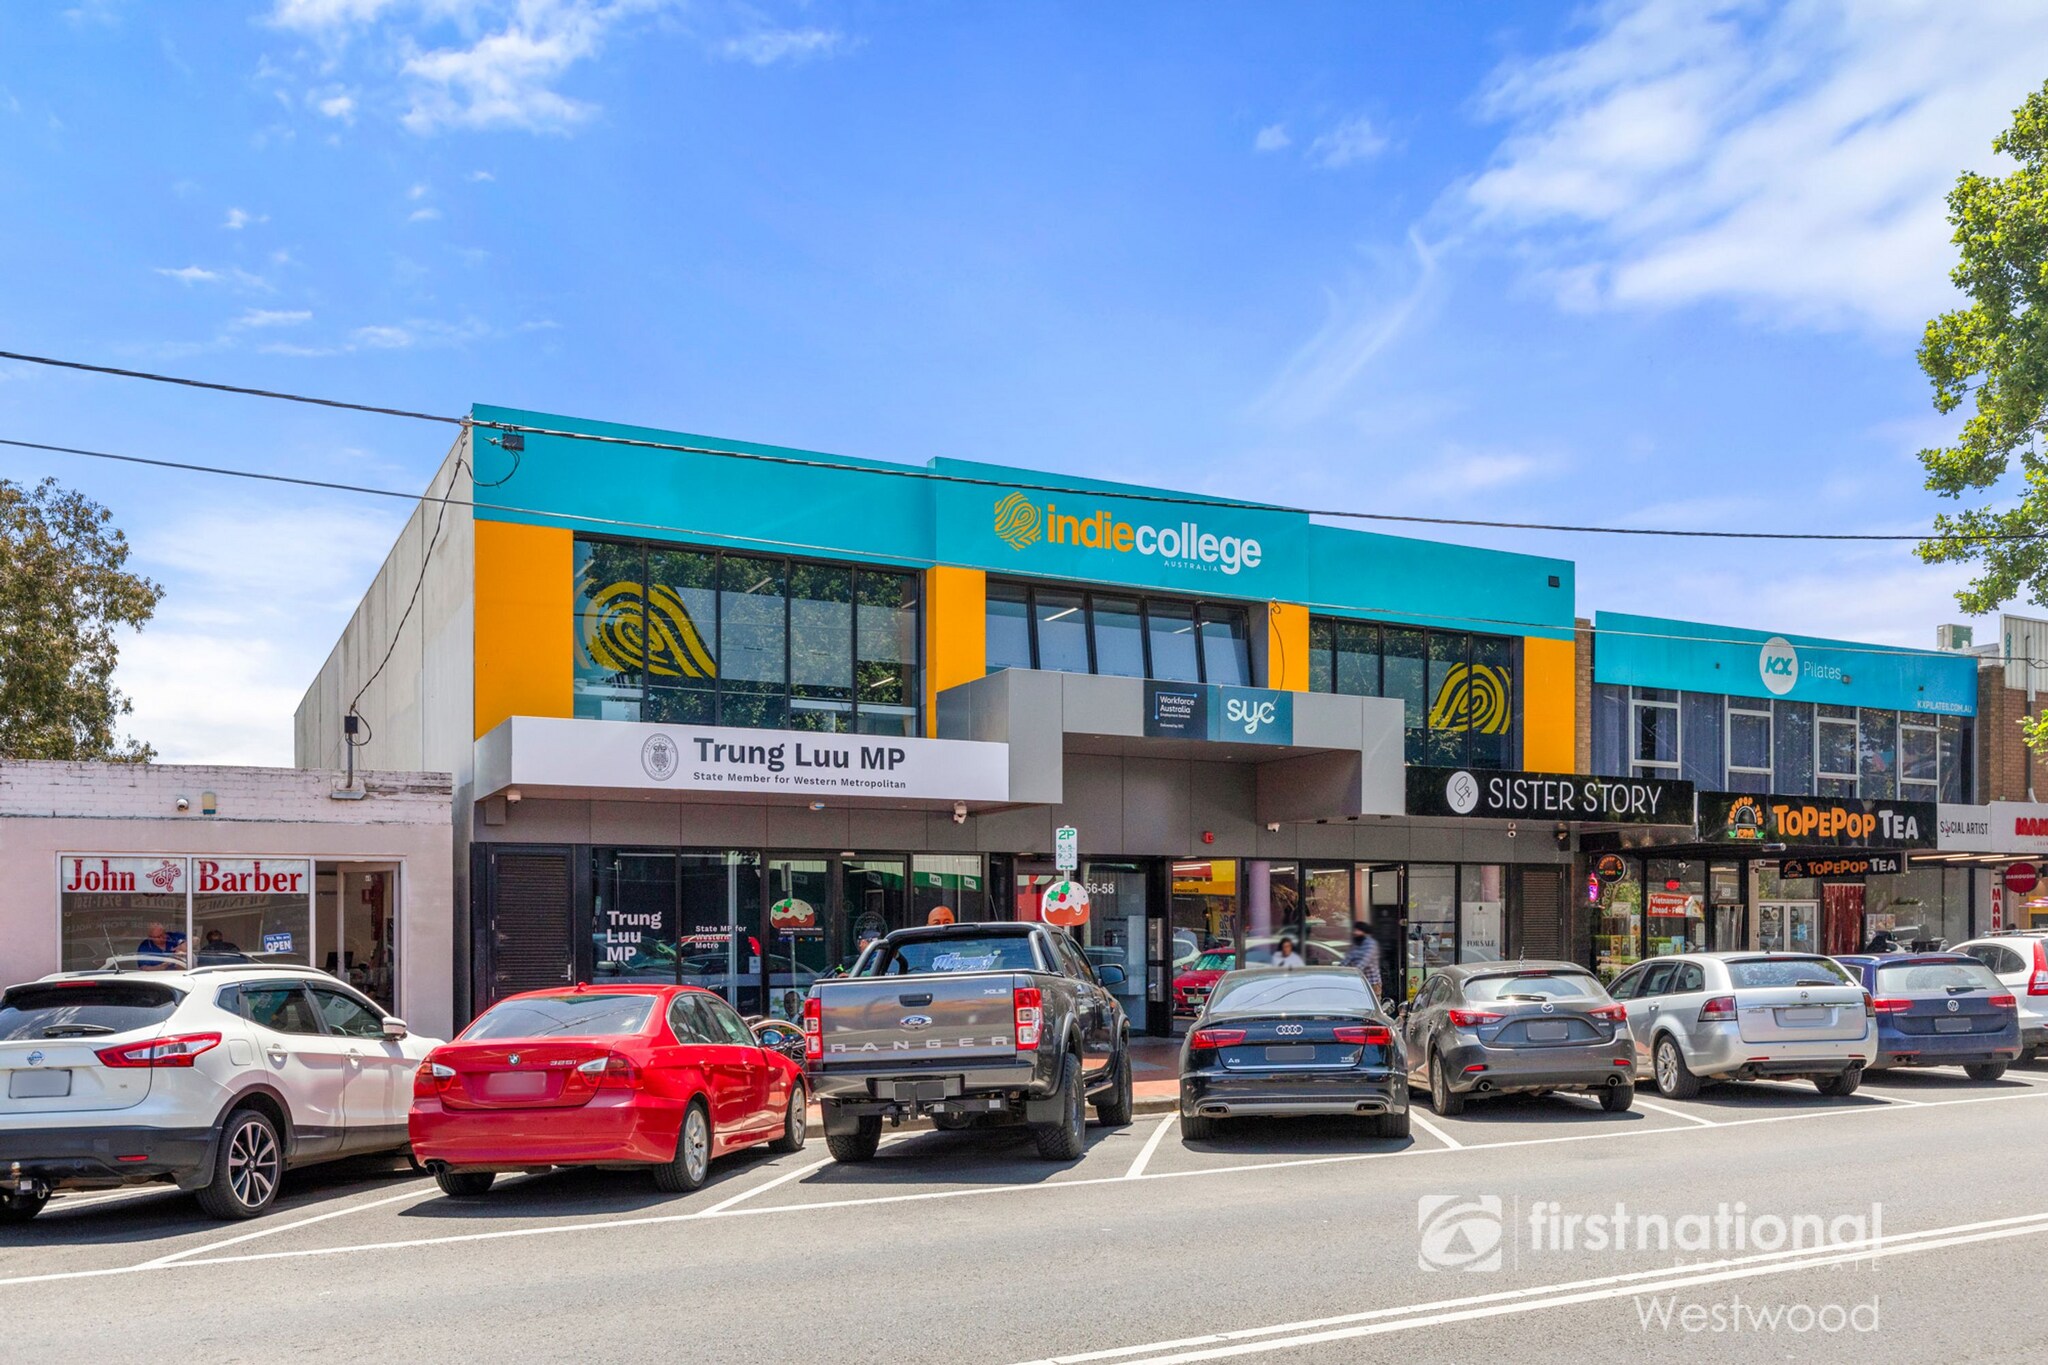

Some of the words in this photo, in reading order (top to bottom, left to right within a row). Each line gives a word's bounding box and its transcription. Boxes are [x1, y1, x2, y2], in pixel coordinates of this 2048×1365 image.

[1164, 560, 1219, 572] AUSTRALIA
[1804, 661, 1841, 680] Pilates
[1160, 696, 1195, 706] Workforce
[1160, 705, 1191, 713] Australia
[693, 737, 785, 772] Trung
[796, 743, 849, 768] Luu
[861, 746, 905, 770] MP
[693, 771, 723, 781] State
[727, 773, 770, 784] Member
[775, 774, 790, 784] for
[794, 776, 837, 786] Western
[841, 778, 906, 789] Metropolitan
[1488, 778, 1574, 811] SISTER
[1583, 782, 1662, 814] STORY
[1878, 809, 1919, 840] TEA
[1966, 822, 1988, 835] ARTIST
[1058, 829, 1075, 840] 2P
[1870, 858, 1896, 872] TEA
[67, 859, 136, 891] John
[199, 861, 303, 892] Barber
[1086, 883, 1114, 894] 56-58
[1651, 897, 1684, 905] Vietnamese
[1992, 888, 2001, 936] MAN
[606, 911, 662, 929] Trung
[606, 929, 642, 944] Luu
[267, 940, 291, 951] OPEN
[606, 946, 637, 961] MP
[831, 1036, 1008, 1053] RANGER
